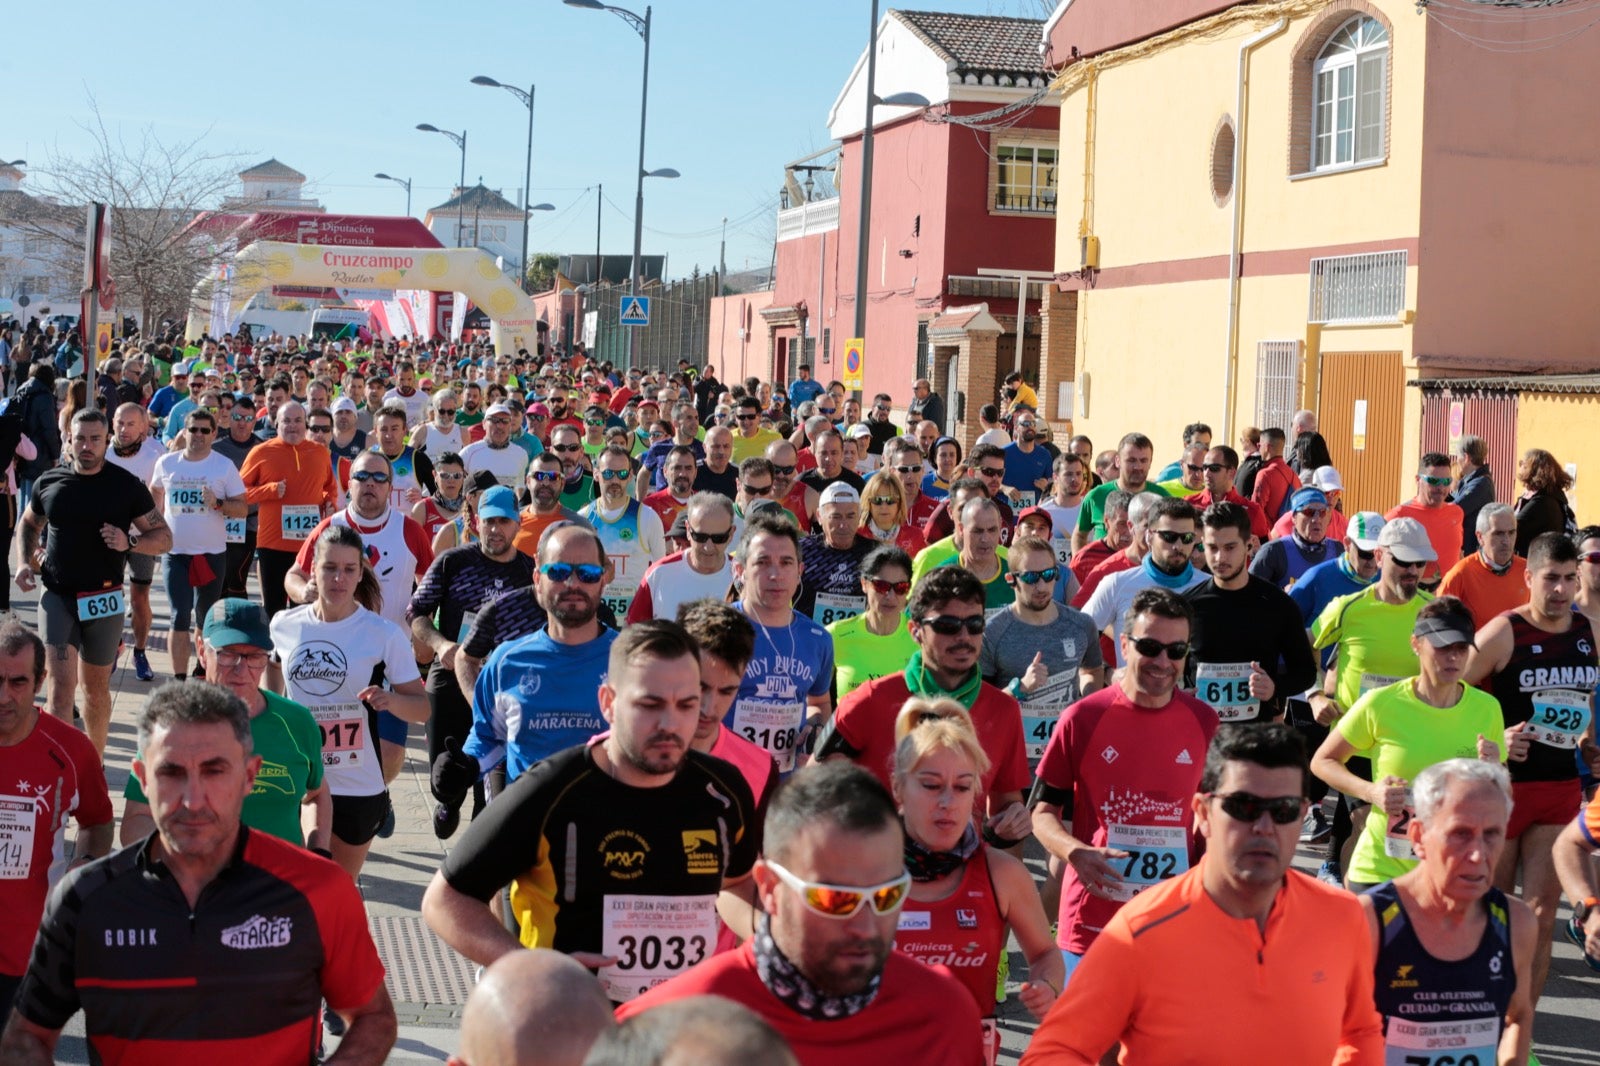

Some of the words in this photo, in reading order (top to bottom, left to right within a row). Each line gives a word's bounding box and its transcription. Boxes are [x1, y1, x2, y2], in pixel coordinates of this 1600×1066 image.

[322, 222, 375, 234] Diputación
[321, 234, 332, 244] de
[334, 234, 374, 246] Granada
[323, 251, 413, 270] Cruzcampo
[331, 271, 374, 284] Radler
[284, 516, 319, 530] 1125
[87, 595, 118, 616] 630
[289, 664, 348, 681] Archidona
[745, 657, 768, 678] HOY
[766, 676, 789, 692] CON
[1519, 666, 1598, 688] GRANAD
[1207, 681, 1250, 702] 615
[528, 717, 601, 730] MARACENA
[1542, 707, 1583, 730] 928
[743, 726, 795, 751] 3168
[1123, 850, 1177, 880] 782
[634, 901, 654, 910] GRAN
[104, 929, 157, 947] GOBIK
[230, 920, 287, 946] ATARFE
[616, 935, 706, 970] 3033
[903, 942, 953, 952] Clínicas
[912, 952, 988, 967] salud
[1413, 991, 1438, 1000] CLUB
[1440, 990, 1486, 1000] ATLETISMO
[1398, 1002, 1441, 1014] CIUDAD
[1449, 1001, 1497, 1013] GRANADA
[1418, 1026, 1437, 1036] GRAN
